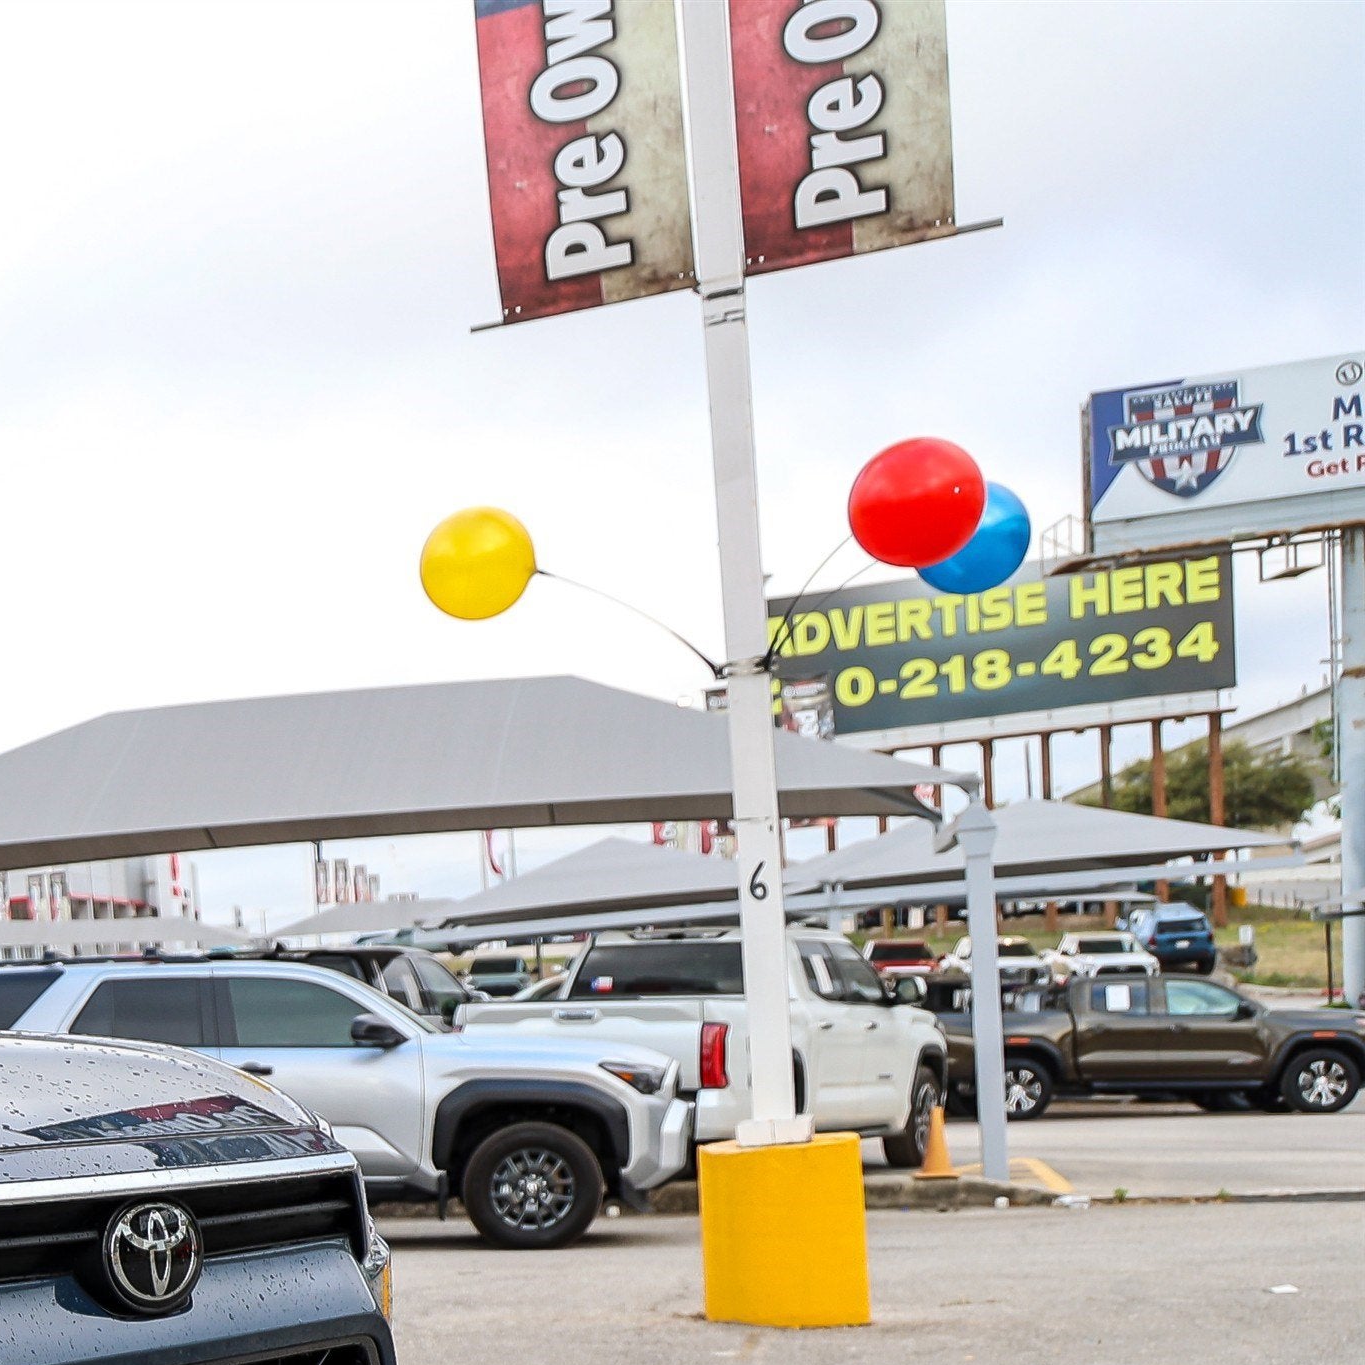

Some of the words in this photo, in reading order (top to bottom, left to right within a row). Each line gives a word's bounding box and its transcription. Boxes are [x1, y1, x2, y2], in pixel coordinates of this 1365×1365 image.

[783, 0, 879, 62] O
[795, 73, 886, 228] Pre
[547, 133, 632, 280] Pre
[1115, 409, 1255, 450] MILITARY
[1333, 393, 1363, 420] M
[1283, 431, 1333, 457] 1st
[1343, 424, 1365, 447] R
[768, 582, 1047, 657] ADVERTISE
[1070, 557, 1220, 619] HERE
[770, 622, 1219, 713] 0-218-4234
[750, 860, 766, 900] 6
